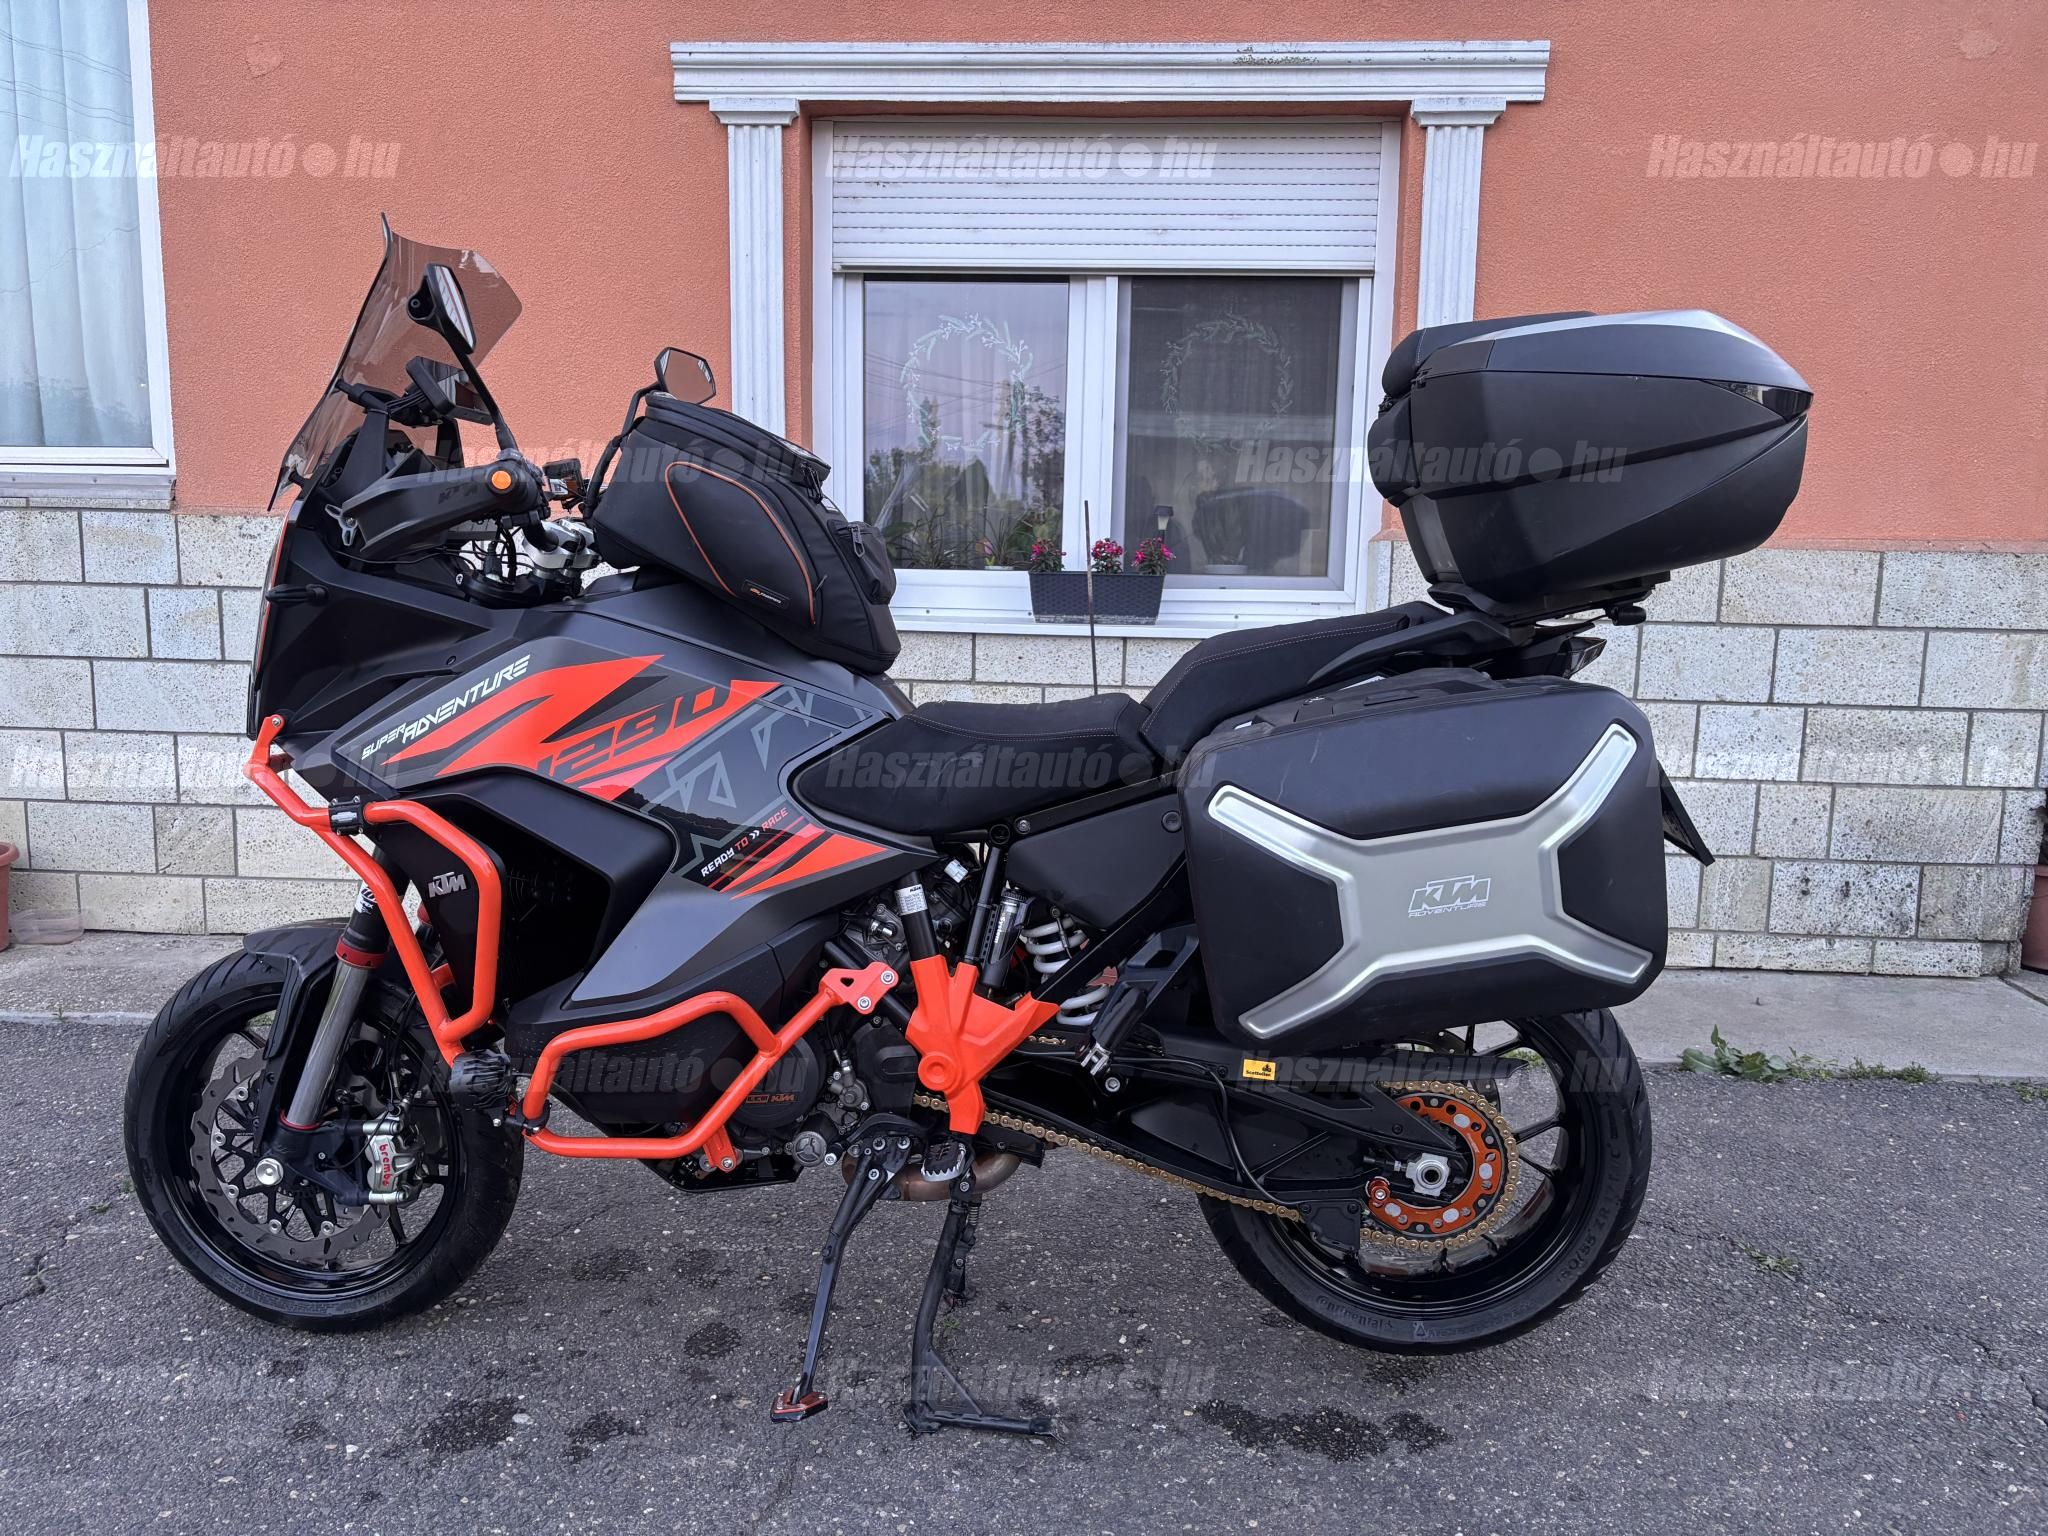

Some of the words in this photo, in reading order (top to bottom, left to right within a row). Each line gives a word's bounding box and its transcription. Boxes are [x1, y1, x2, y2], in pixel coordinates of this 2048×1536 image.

[362, 722, 406, 760] SUPER
[402, 654, 531, 744] ADVENTURE
[537, 683, 731, 783] 1290
[700, 847, 735, 877] READY
[735, 836, 749, 851] TO
[761, 807, 789, 832] RACE
[428, 871, 467, 899] KTM
[1408, 874, 1491, 913] KTM
[1408, 902, 1487, 919] ADVENTURE
